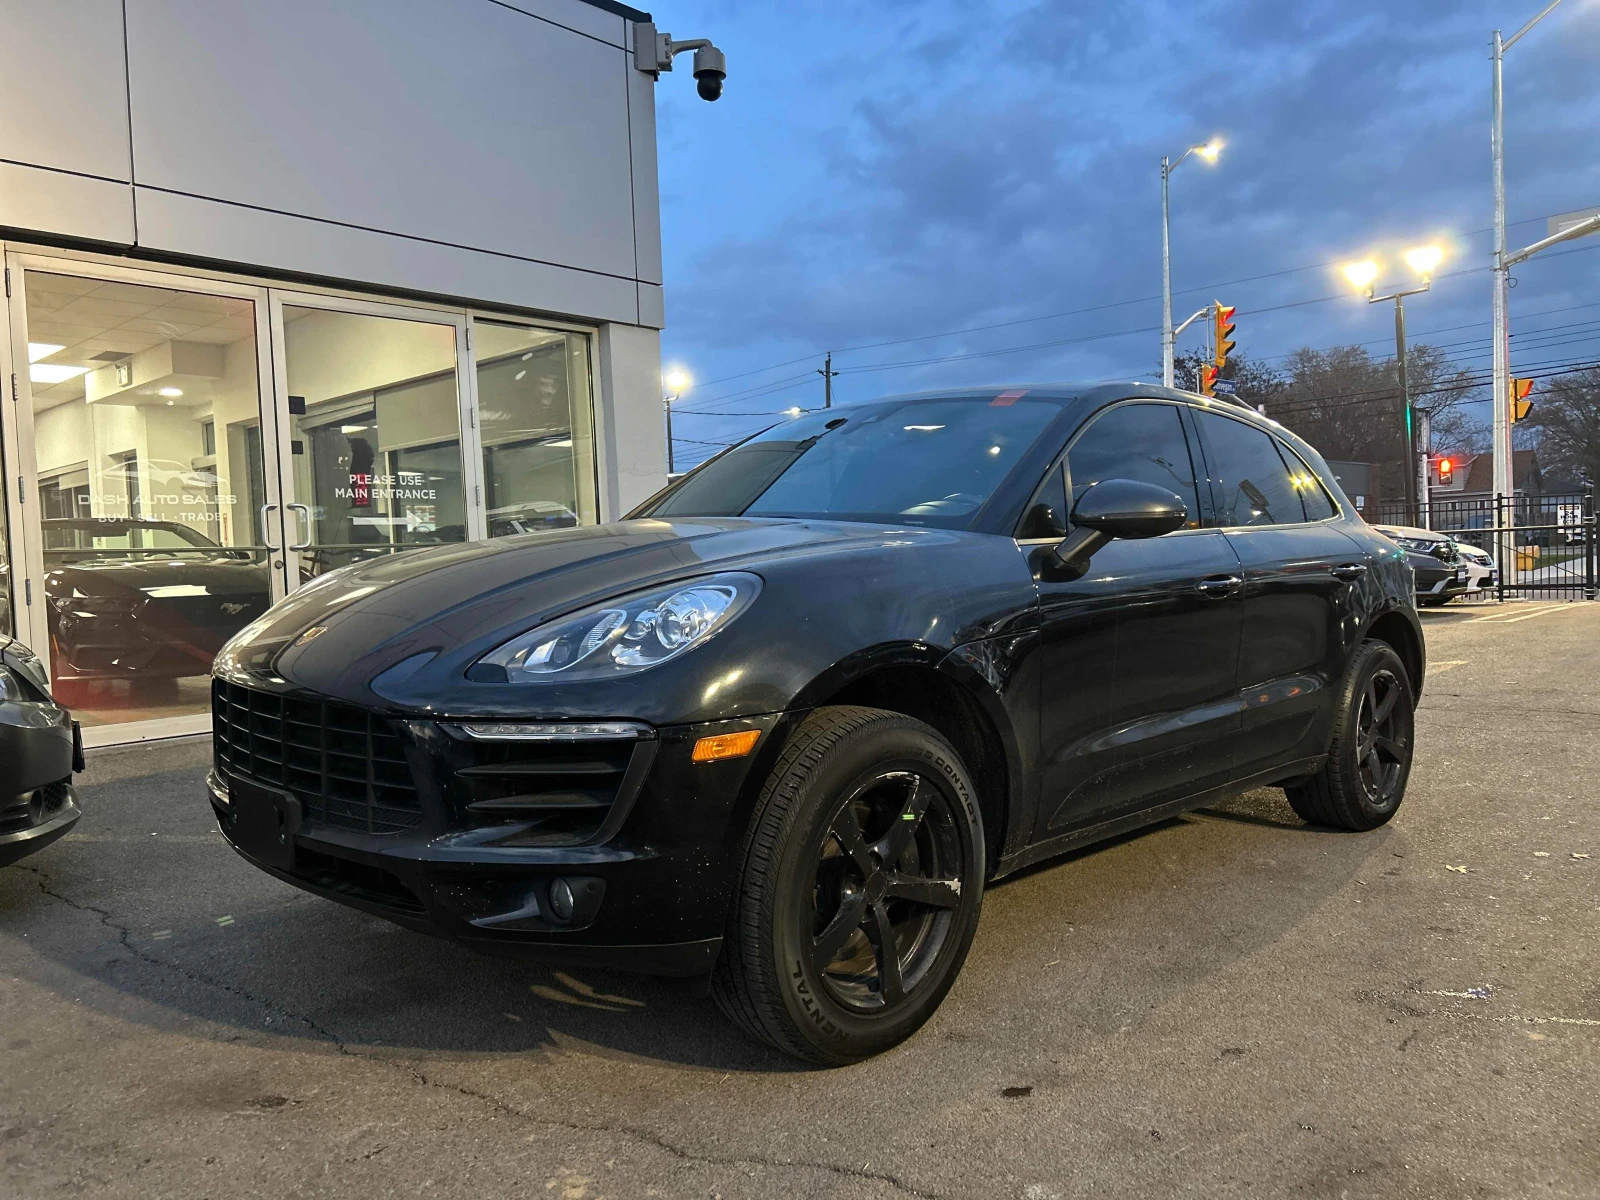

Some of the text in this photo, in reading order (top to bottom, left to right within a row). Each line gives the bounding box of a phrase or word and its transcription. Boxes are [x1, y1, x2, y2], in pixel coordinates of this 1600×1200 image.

[349, 474, 423, 486] PLEASE USE
[335, 488, 437, 499] MAIN ENTRANCE
[78, 494, 238, 505] DASH AUTO SALES
[98, 512, 222, 523] BUY SELL TRADE
[935, 756, 978, 826] CONTACT
